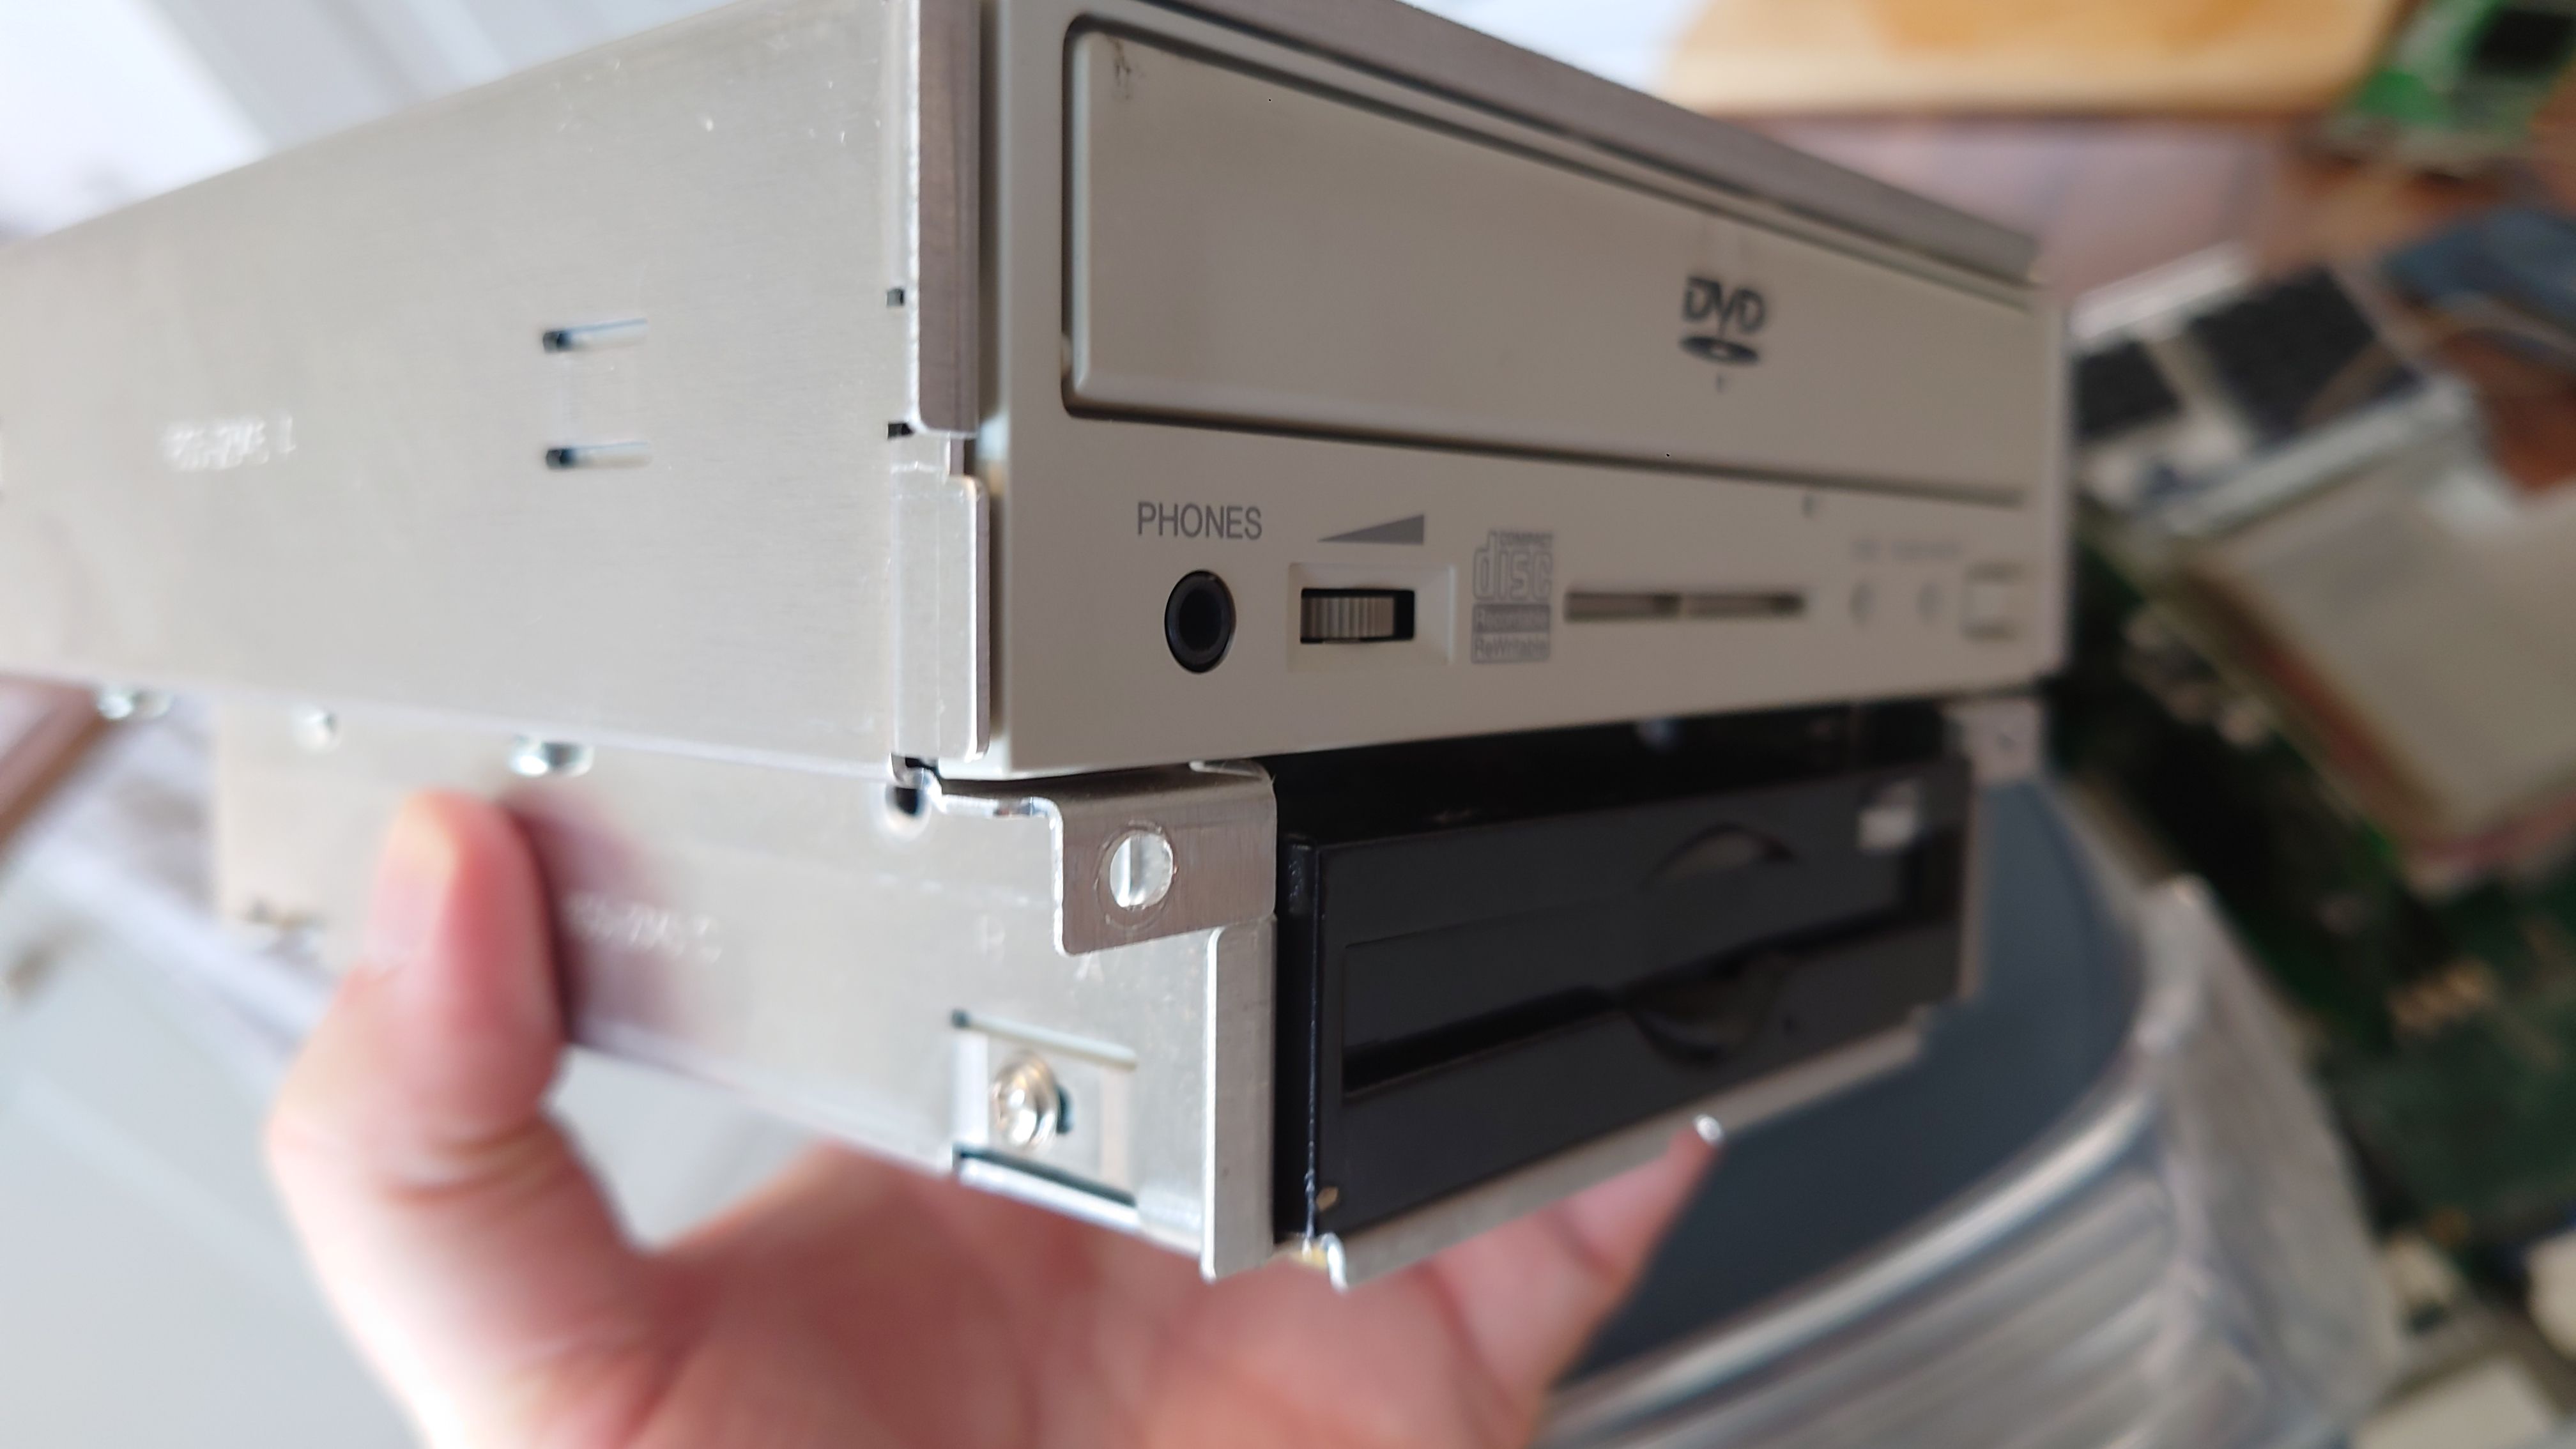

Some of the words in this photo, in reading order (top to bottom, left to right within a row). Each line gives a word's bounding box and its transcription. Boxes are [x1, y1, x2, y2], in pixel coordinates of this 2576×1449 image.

[1682, 275, 1767, 336] DVD
[1137, 501, 1262, 540] PHONES
[1472, 530, 1552, 601] disc
